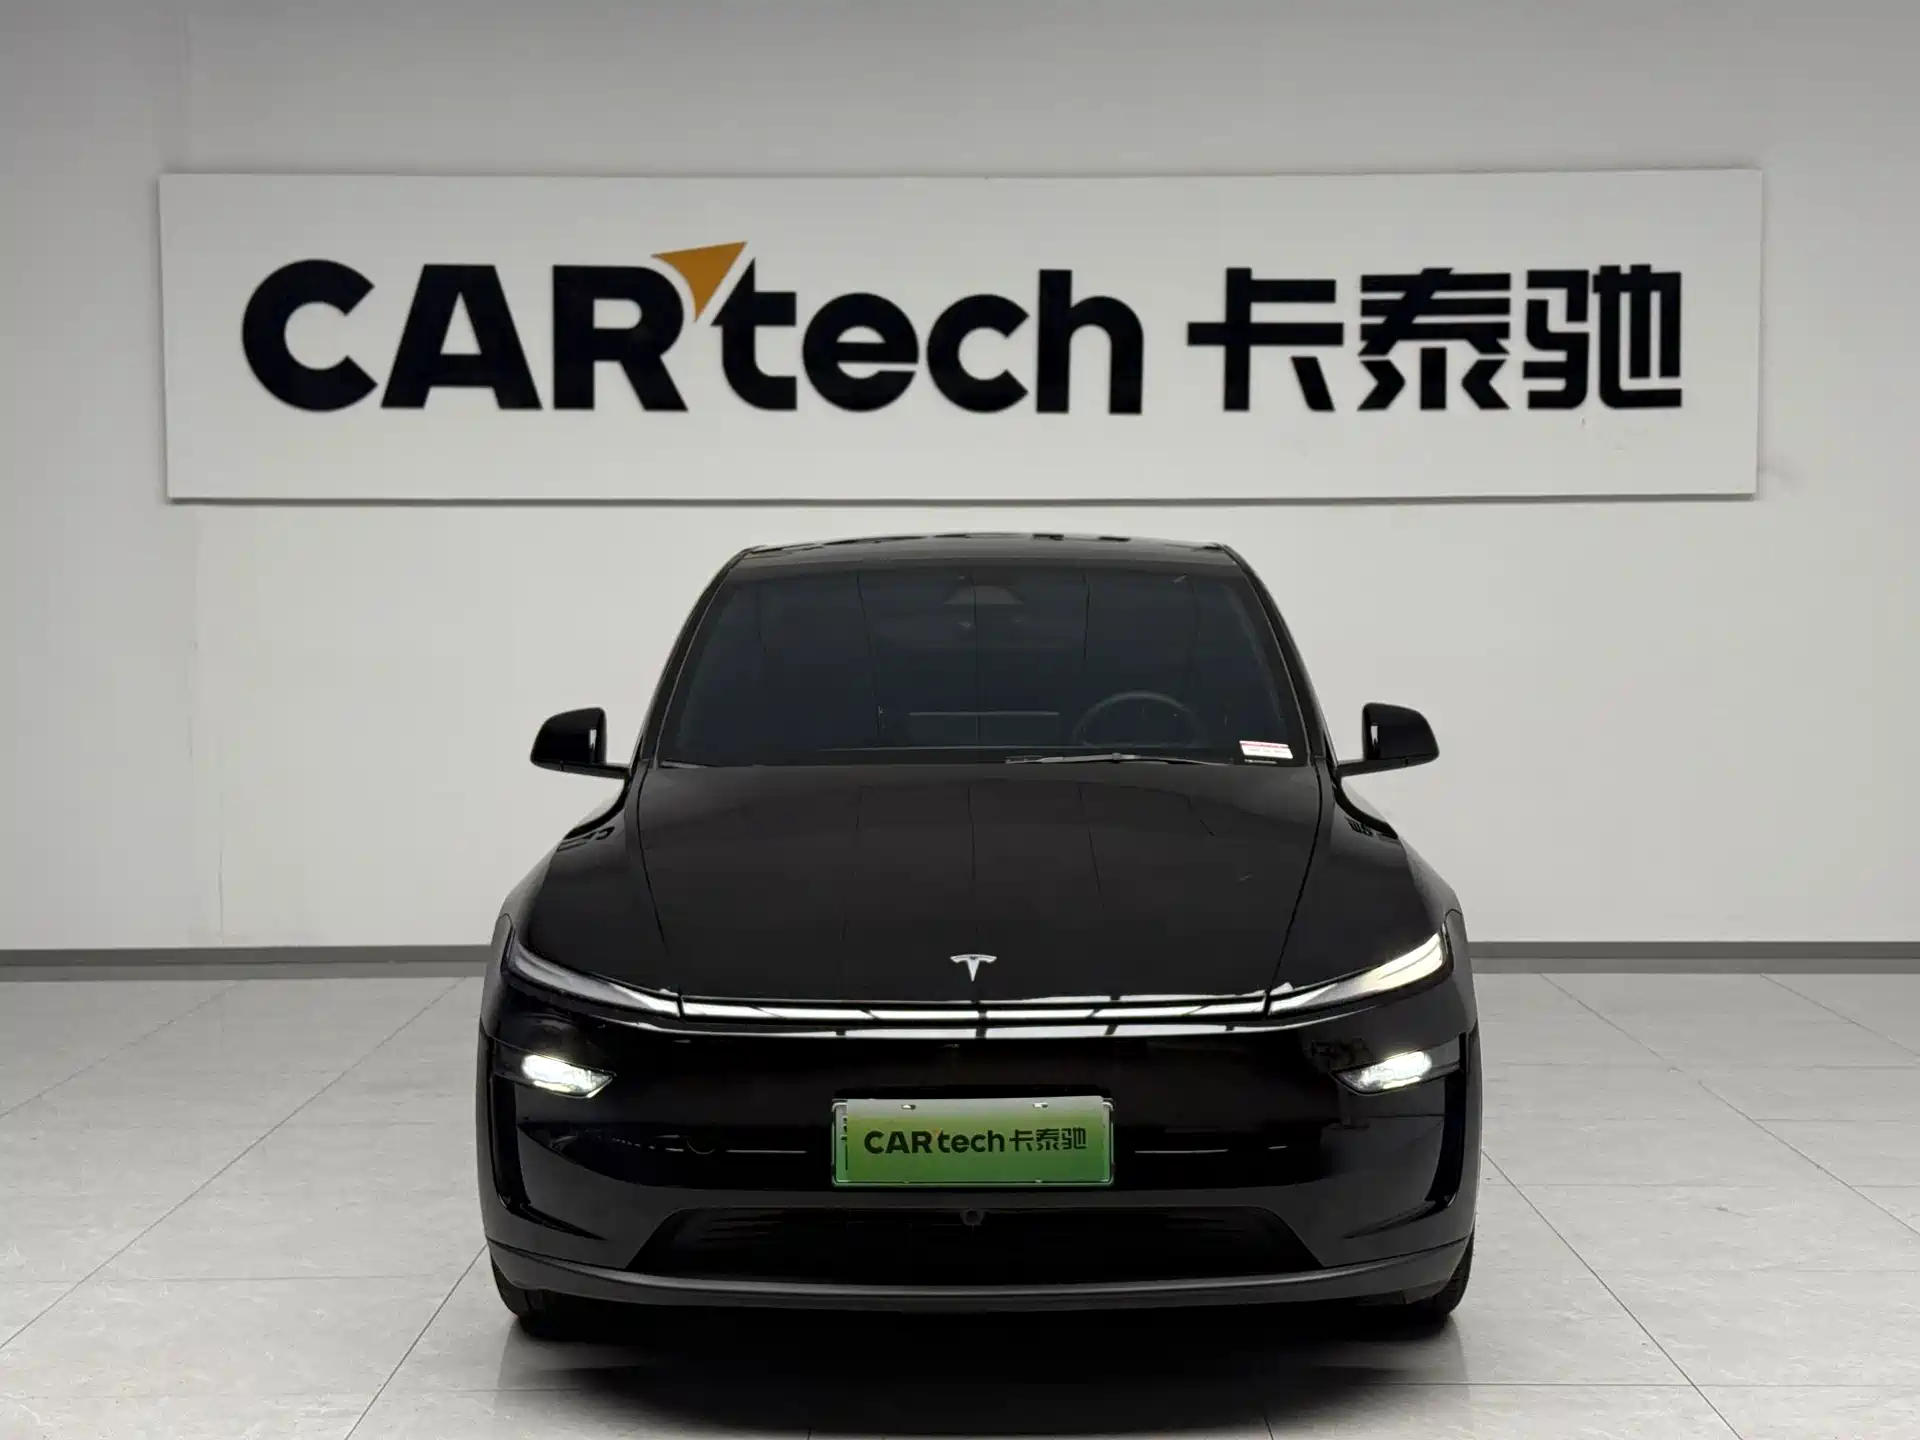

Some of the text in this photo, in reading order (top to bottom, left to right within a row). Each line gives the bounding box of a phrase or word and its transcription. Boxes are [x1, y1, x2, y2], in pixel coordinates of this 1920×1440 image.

[242, 258, 1684, 414] CARtech 卡泰驰
[864, 1129, 1005, 1154] CARtech
[1009, 1126, 1087, 1152] 卡泰驰
